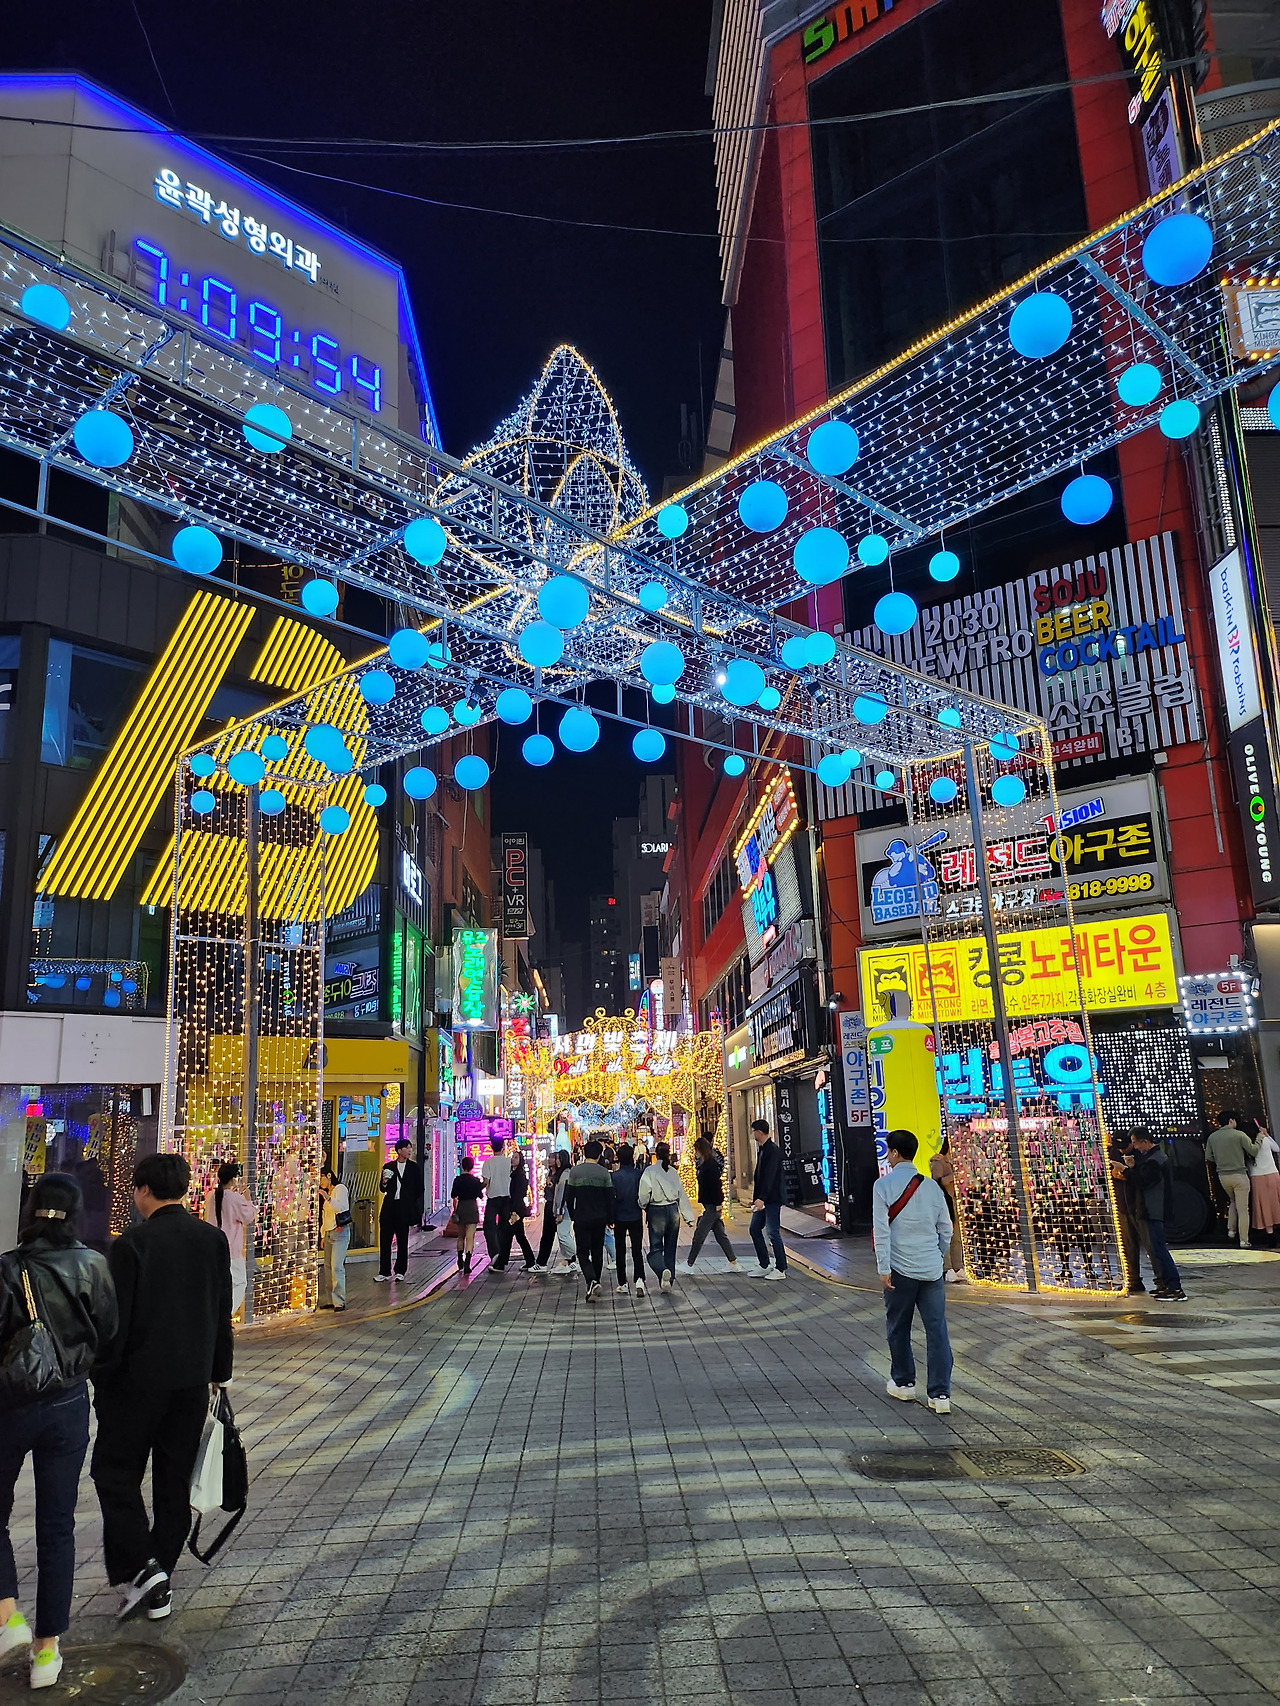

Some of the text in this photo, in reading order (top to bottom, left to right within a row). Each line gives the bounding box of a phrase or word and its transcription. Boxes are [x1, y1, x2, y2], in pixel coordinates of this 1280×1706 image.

[153, 168, 322, 285] 윤곽성형외과
[136, 238, 382, 412] 7:09:54
[1032, 566, 1108, 614] SOJU
[924, 601, 1000, 649] 2030
[1036, 600, 1111, 646] BEER
[1219, 567, 1234, 629] baskin
[1231, 654, 1248, 718] robbins
[1038, 615, 1186, 677] COCKTAIL
[1048, 669, 1191, 733] 소주클럽
[1117, 722, 1144, 750] B1
[1244, 743, 1260, 796] OLIVE
[505, 848, 525, 887] PC
[1253, 820, 1272, 884] YOUNG
[506, 894, 525, 906] VR
[1069, 872, 1153, 900] 818-9998
[917, 998, 962, 1011] KINKONG
[1190, 996, 1242, 1011] 레전드
[1221, 980, 1236, 993] 5F
[917, 1008, 963, 1021] MUSCTOWN
[1191, 1010, 1244, 1025] 야구존
[635, 1053, 673, 1076] Light
[847, 1050, 867, 1106] 야구존
[850, 1110, 869, 1123] 5F
[783, 1126, 792, 1158] FOXY
